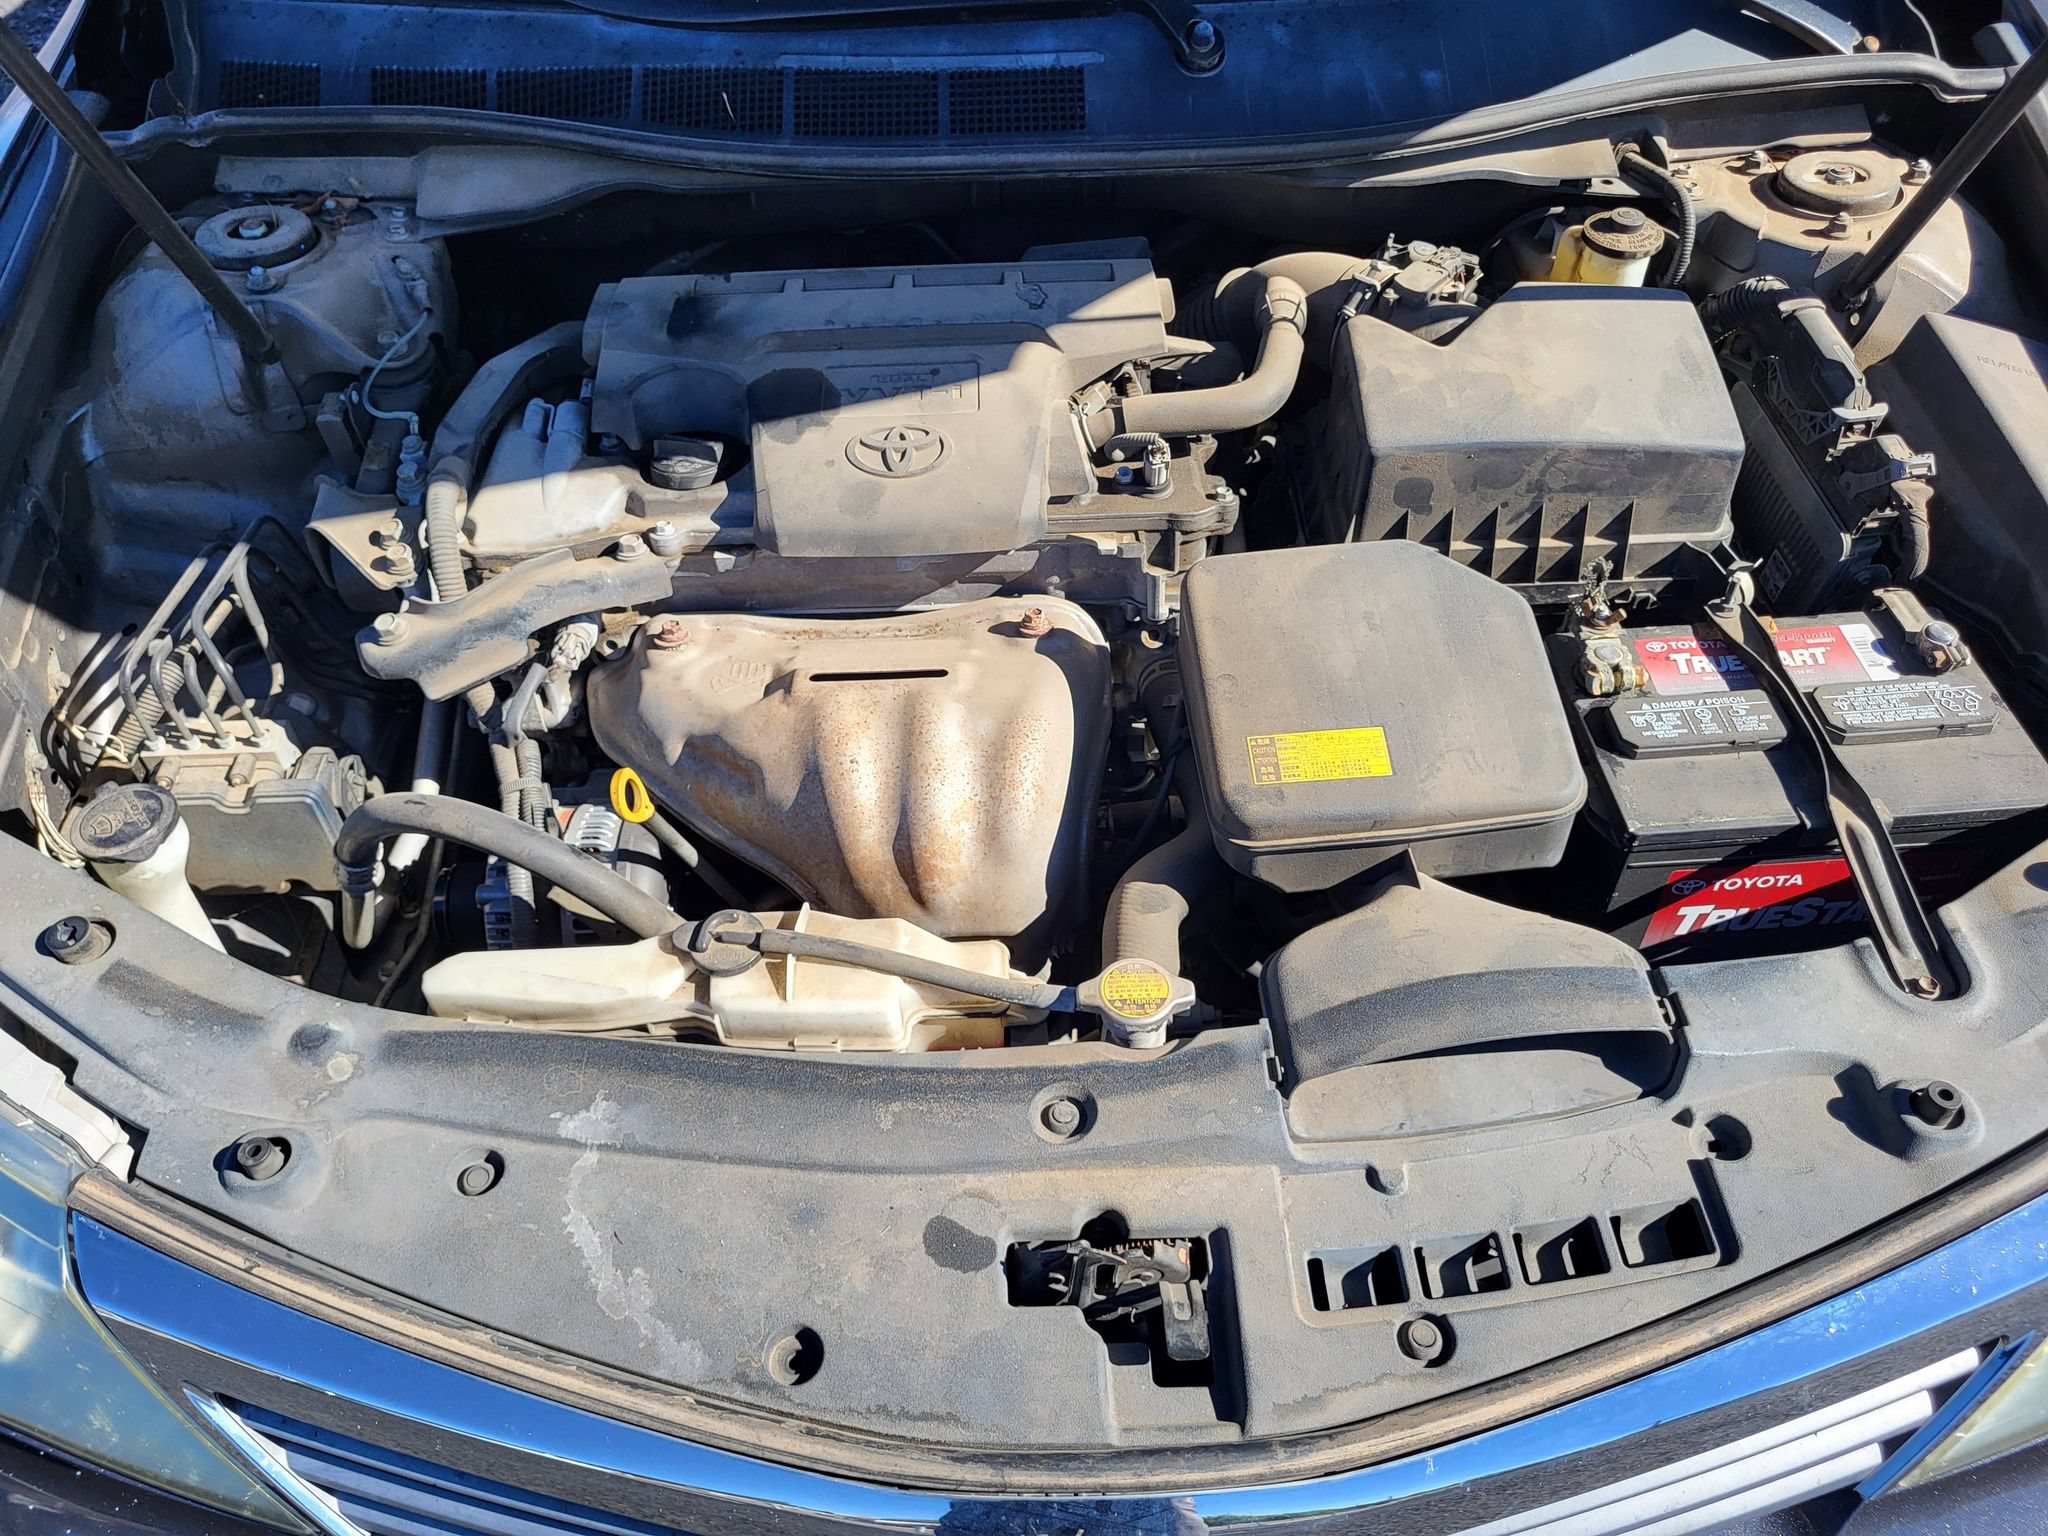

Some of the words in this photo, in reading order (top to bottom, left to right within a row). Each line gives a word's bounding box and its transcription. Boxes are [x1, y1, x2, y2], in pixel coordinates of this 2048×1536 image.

[1667, 640, 1727, 650] TOYOTA
[1651, 700, 1696, 710] DANGER
[1705, 696, 1746, 706] POISON
[1712, 873, 1803, 892] TOYOTA
[1673, 895, 1868, 937] TRUESTA
[1126, 998, 1161, 1006] ATTENTION
